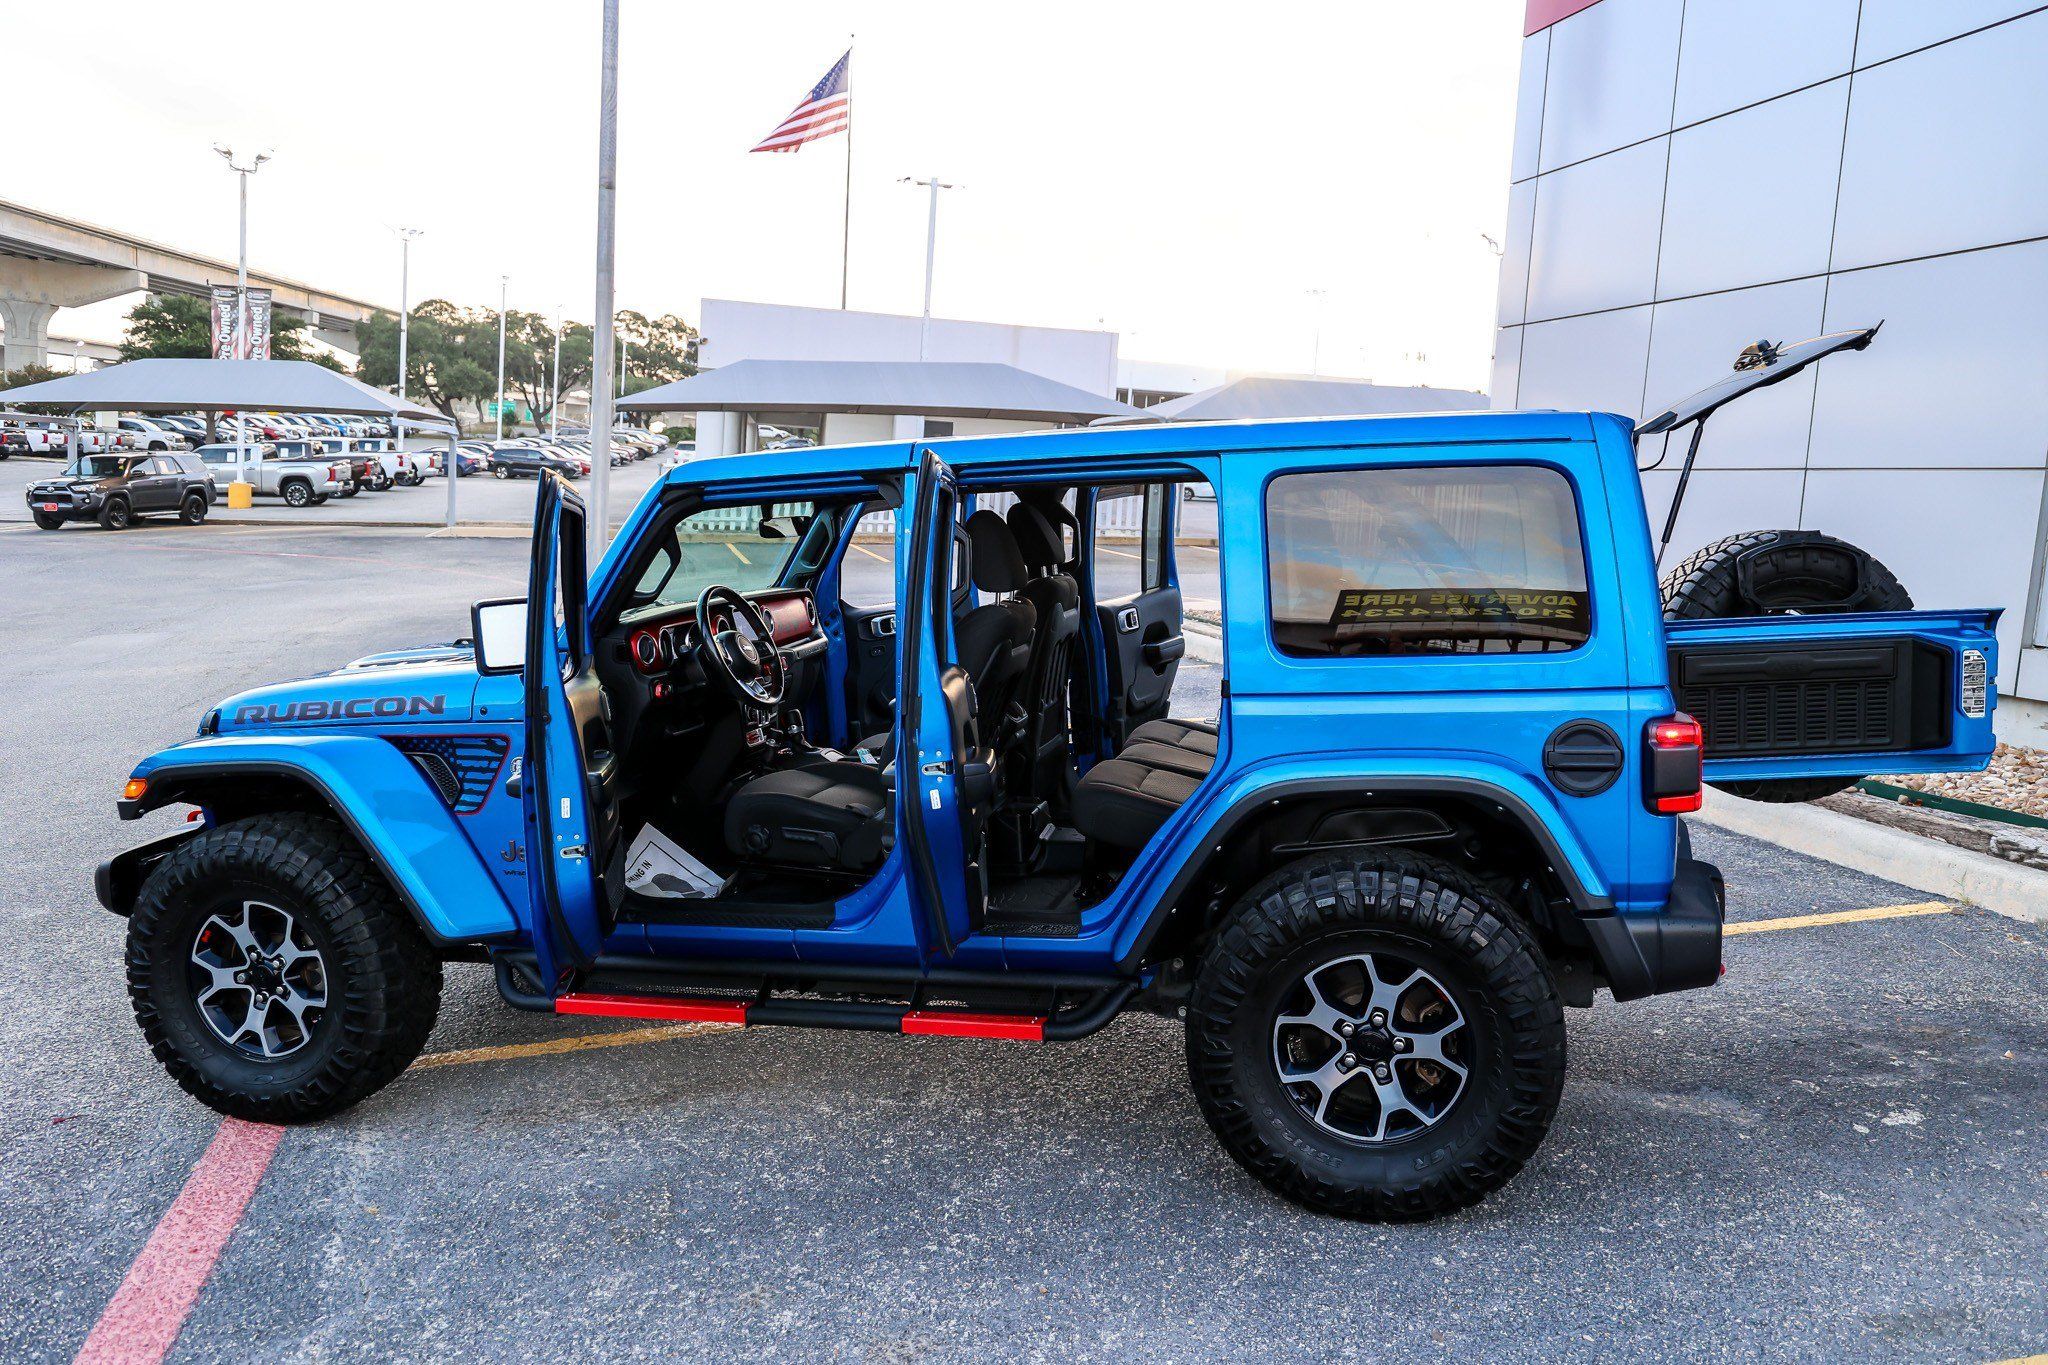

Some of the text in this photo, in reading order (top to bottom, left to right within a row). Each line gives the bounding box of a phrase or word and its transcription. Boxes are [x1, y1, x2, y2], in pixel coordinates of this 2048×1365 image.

[218, 304, 231, 343] Owned
[250, 306, 263, 345] Owned
[234, 695, 446, 724] RUBICON
[501, 839, 525, 862] Je
[641, 859, 652, 870] IN
